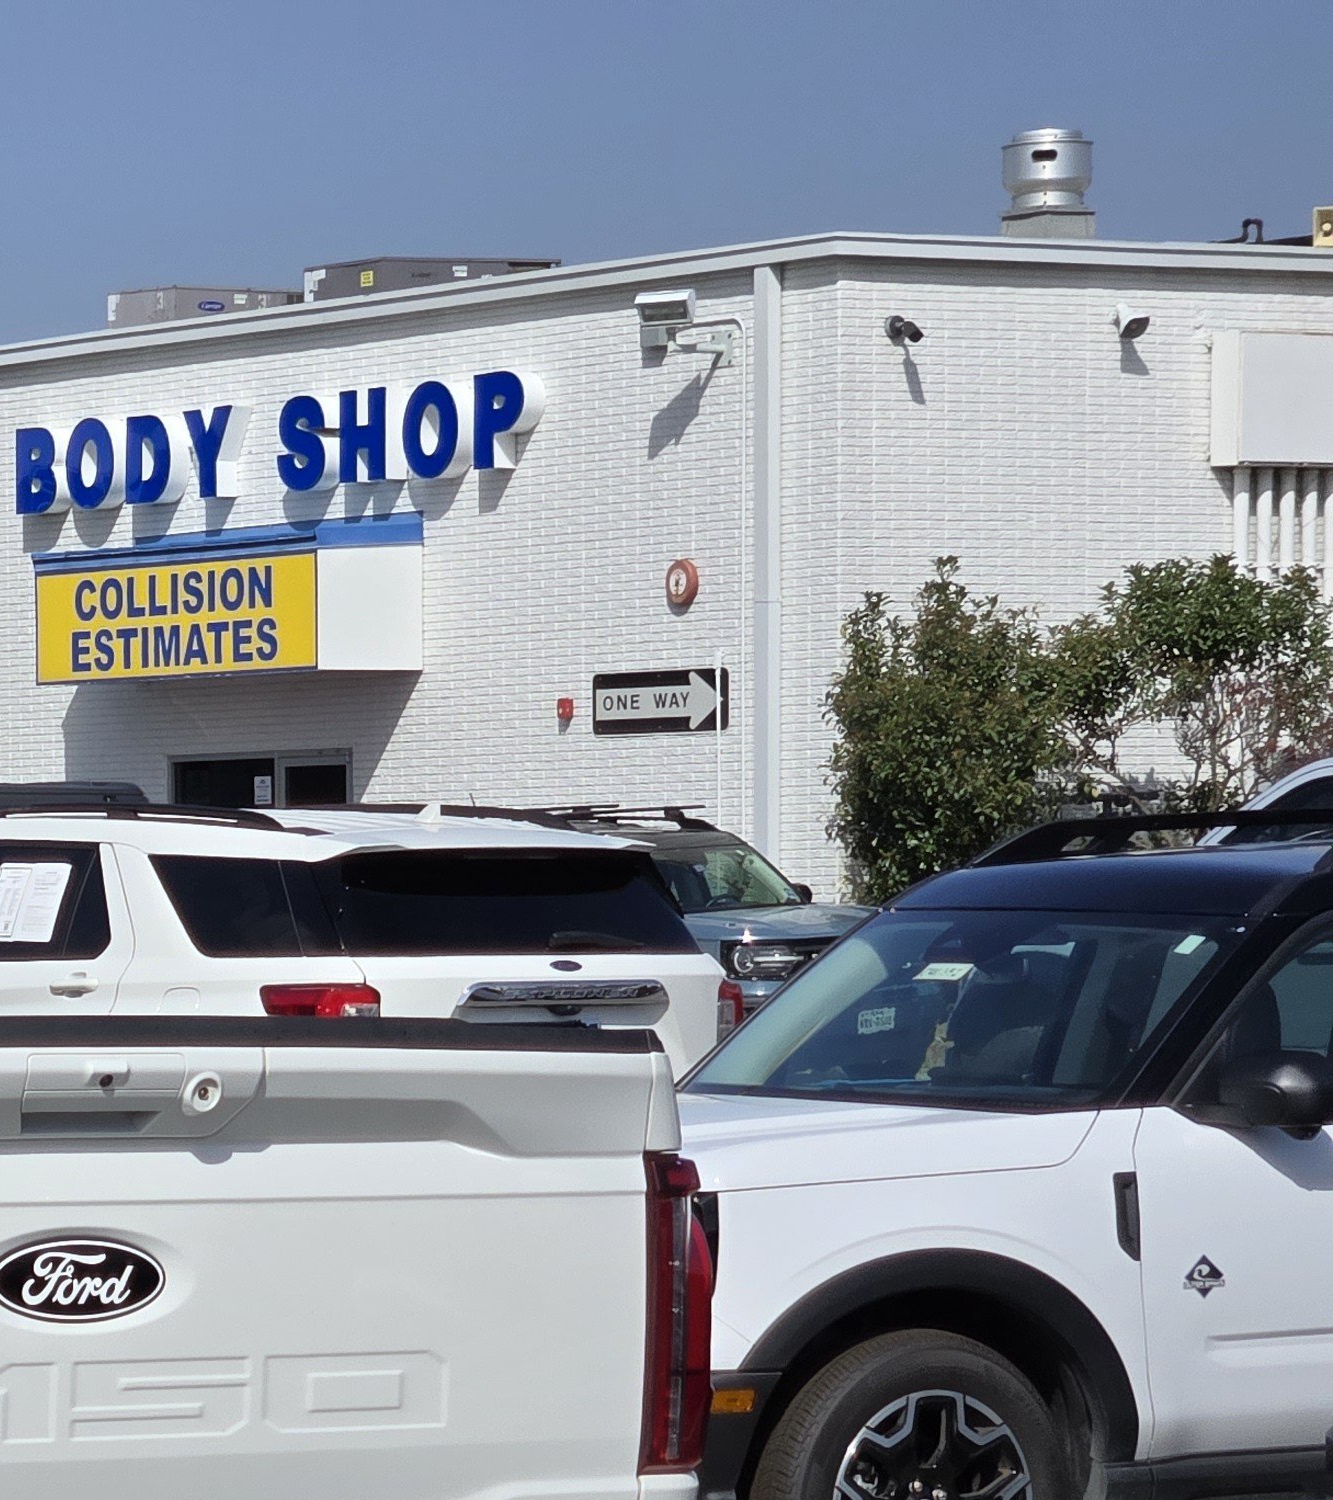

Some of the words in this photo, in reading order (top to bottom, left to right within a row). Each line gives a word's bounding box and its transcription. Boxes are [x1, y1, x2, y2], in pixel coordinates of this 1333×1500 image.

[15, 405, 233, 514] BODY
[276, 370, 526, 492] SHOP
[74, 565, 274, 622] COLLISION
[71, 617, 279, 673] ESTIMATES
[603, 694, 640, 711] ONE
[653, 691, 690, 709] WAY
[20, 1250, 134, 1308] Ford
